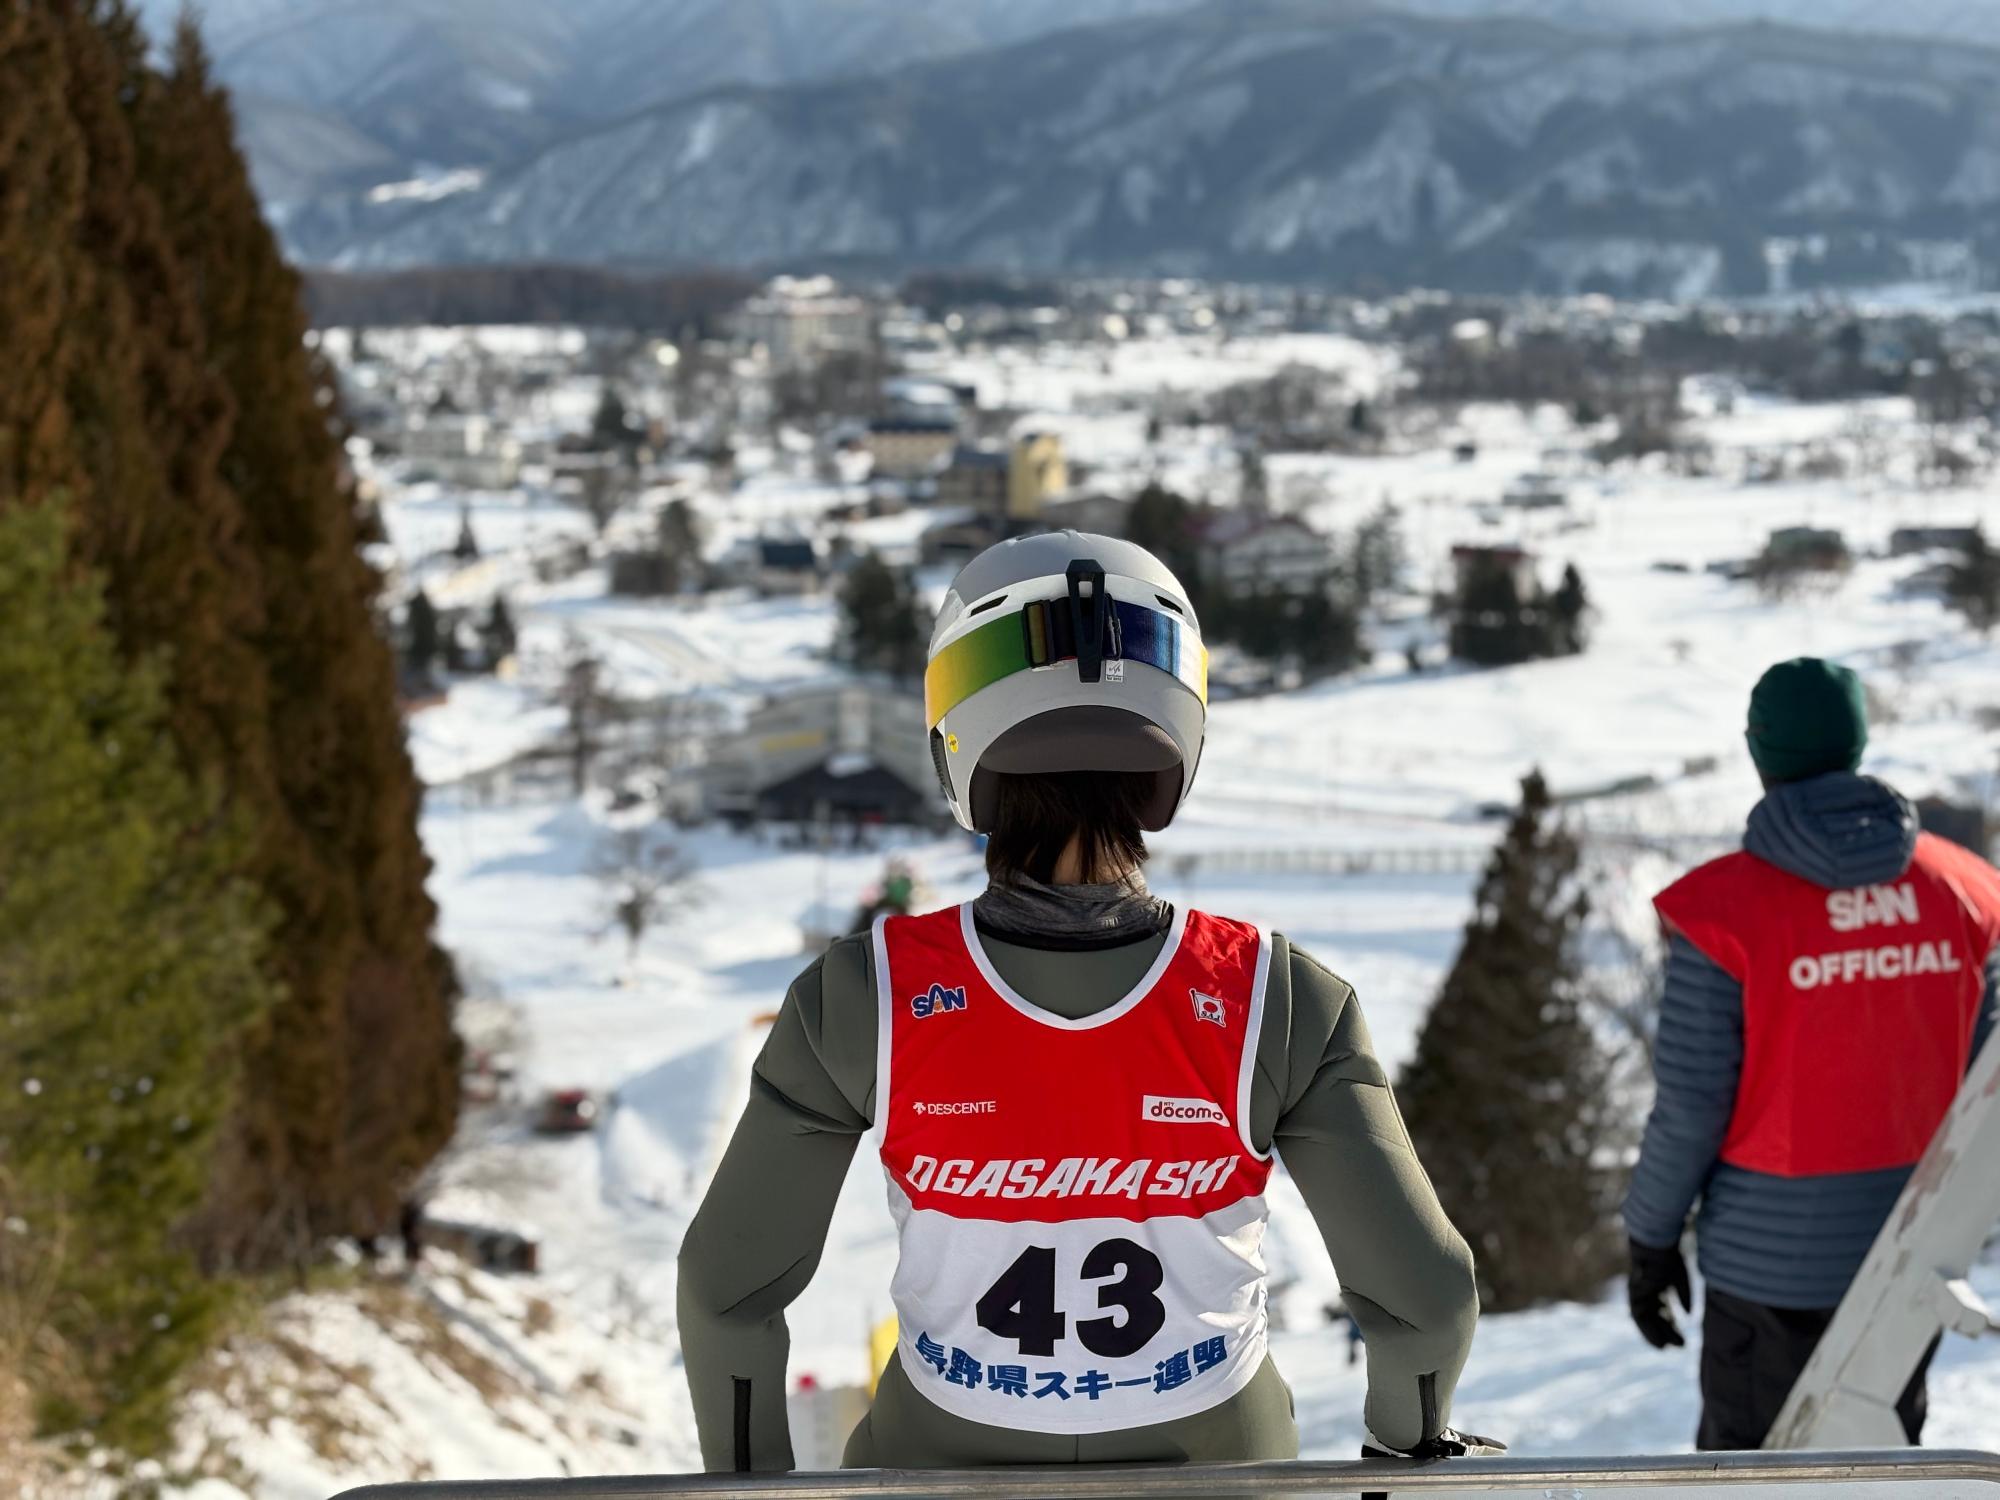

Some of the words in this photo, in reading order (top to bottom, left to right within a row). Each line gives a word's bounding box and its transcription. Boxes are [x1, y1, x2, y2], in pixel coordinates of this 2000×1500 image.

[1826, 883, 1919, 931] SAN
[1789, 941, 1960, 989] OFFICIAL
[911, 983, 967, 1018] SAN
[927, 1101, 996, 1115] DESCENTE
[1151, 1101, 1223, 1120] docomo
[906, 1155, 1152, 1200] OGASAKA
[1149, 1155, 1241, 1199] SKI
[976, 1238, 1166, 1358] 43
